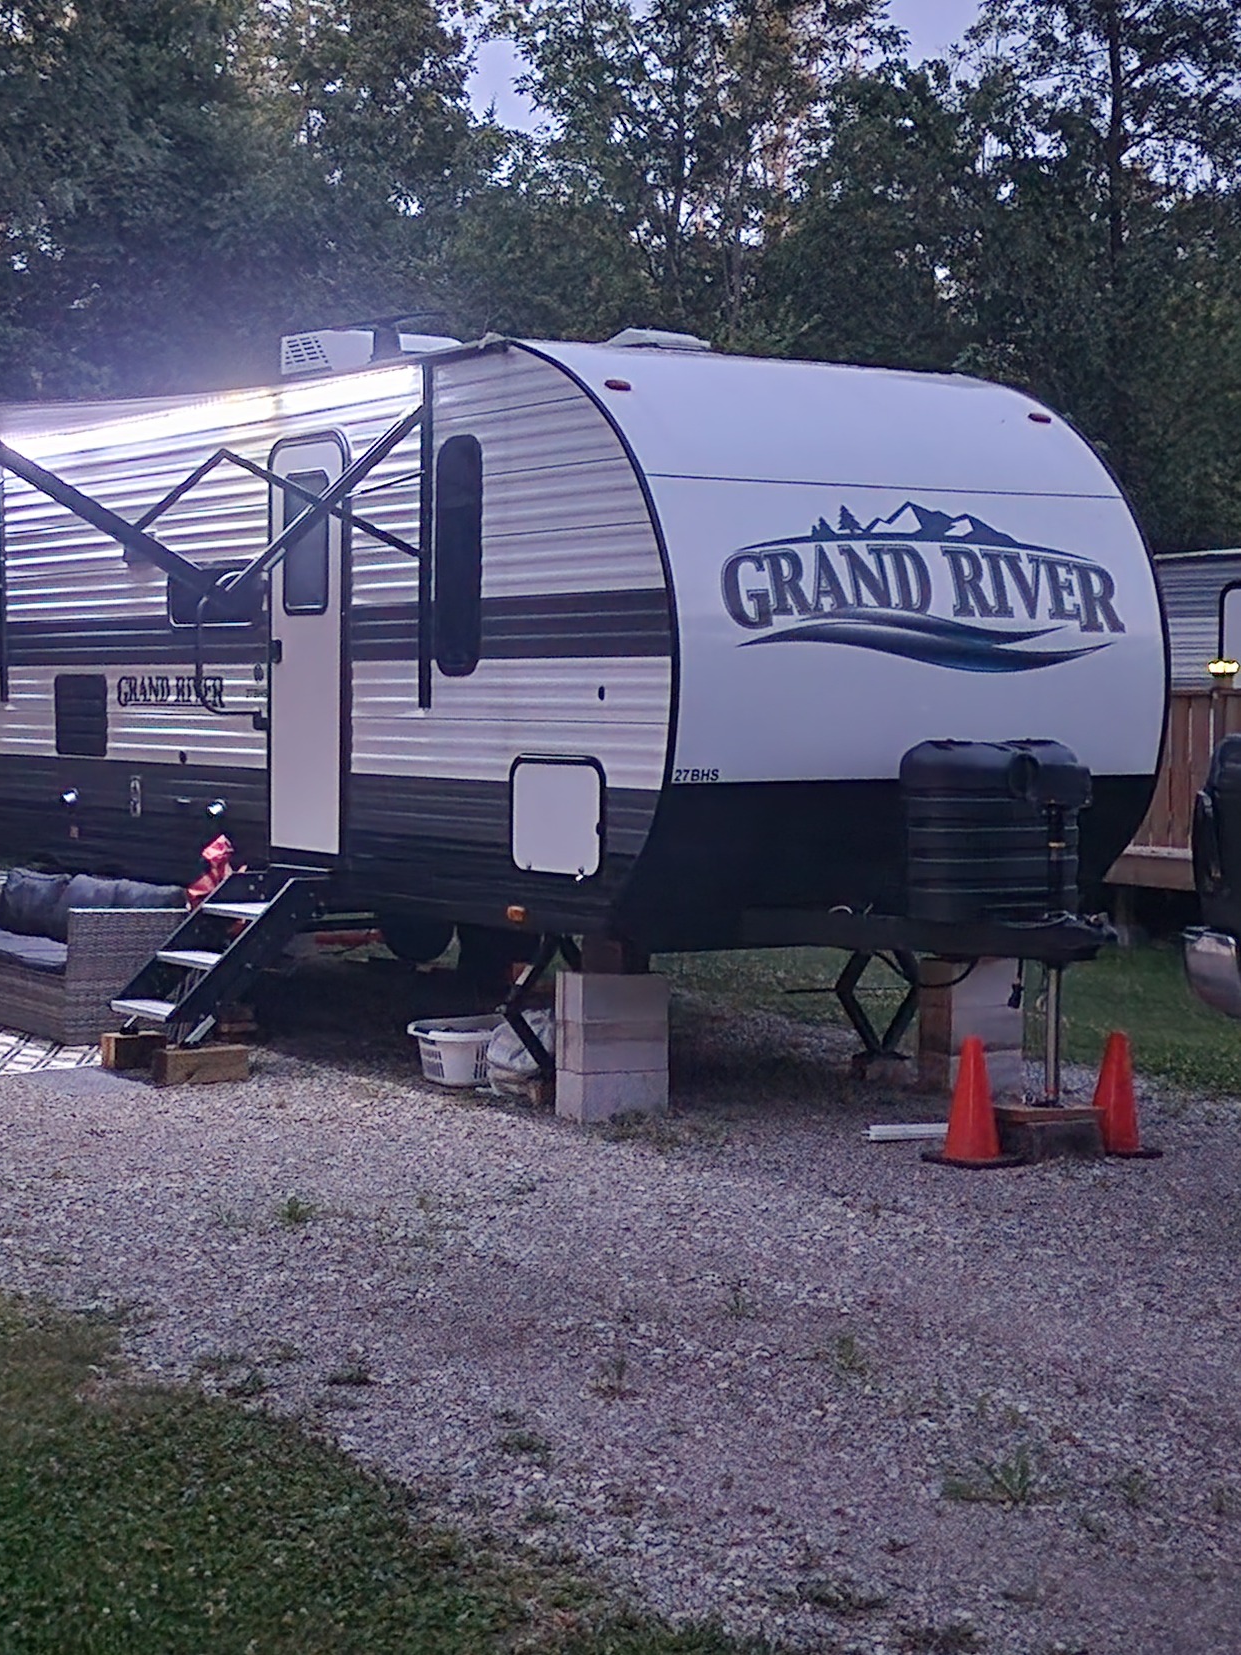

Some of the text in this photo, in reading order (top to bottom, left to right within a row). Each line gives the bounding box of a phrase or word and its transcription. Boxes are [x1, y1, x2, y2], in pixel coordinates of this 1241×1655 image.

[721, 544, 1126, 634] GRAND RIVER
[117, 676, 171, 707] GRAND
[674, 768, 719, 782] 27BHS
